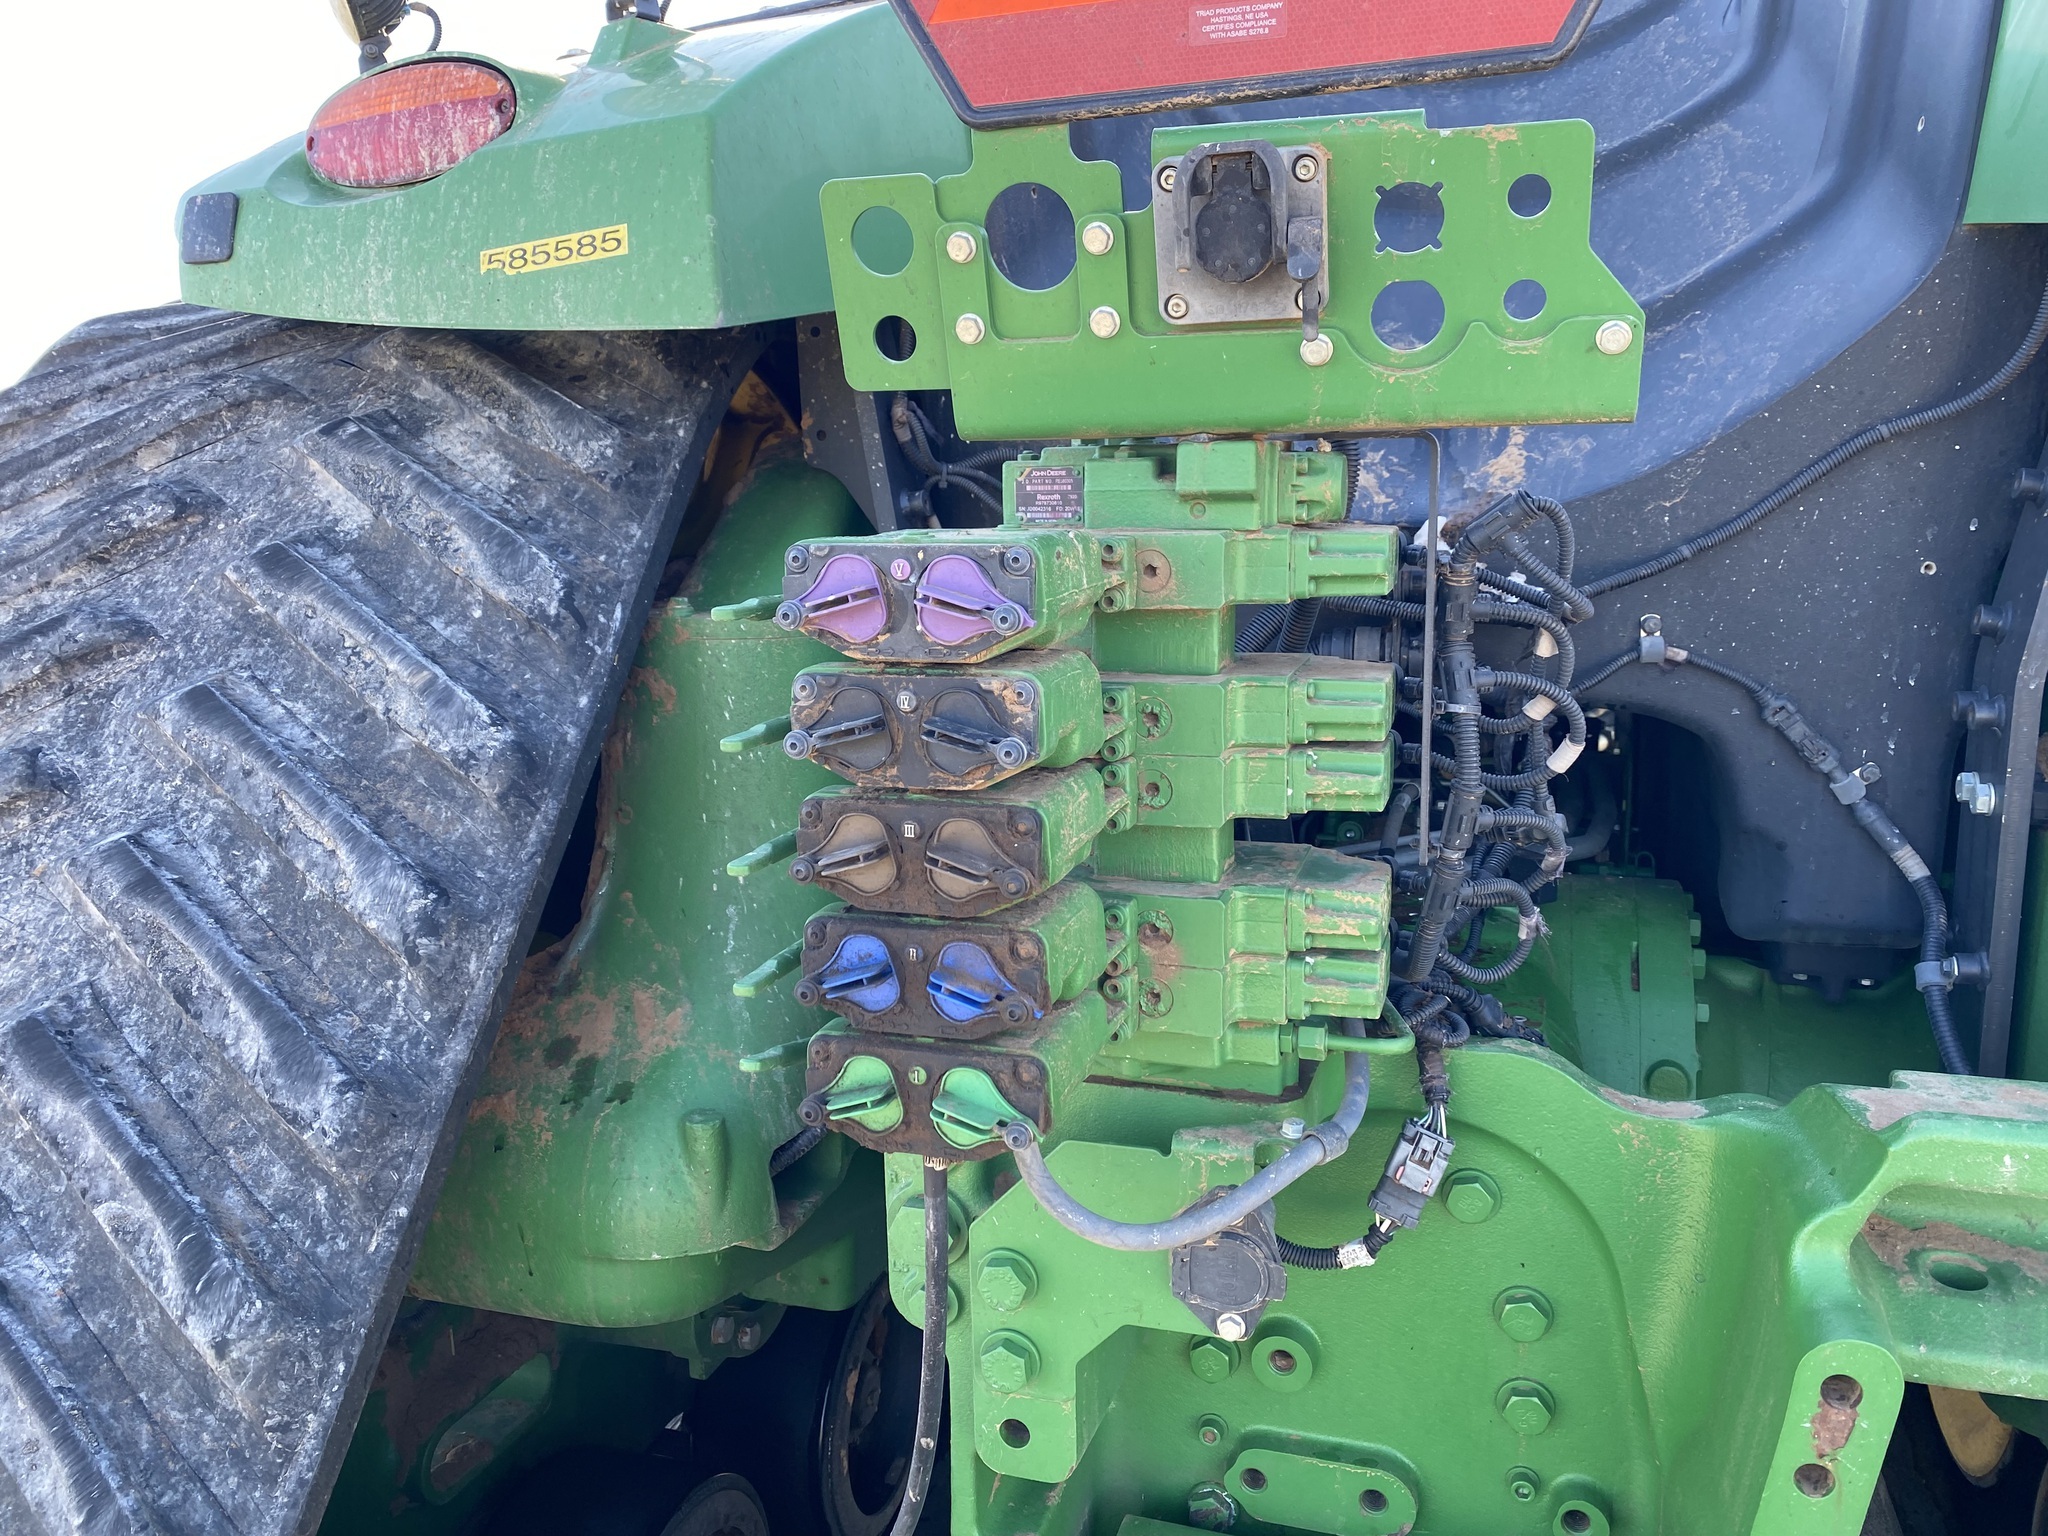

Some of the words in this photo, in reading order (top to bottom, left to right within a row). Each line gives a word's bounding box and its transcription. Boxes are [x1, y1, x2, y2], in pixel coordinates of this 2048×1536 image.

[1196, 9, 1215, 17] TRIAD
[1216, 5, 1250, 15] PRODUCTS
[1252, 2, 1283, 11] COMPANY
[1255, 11, 1269, 19] USA
[1202, 23, 1234, 32] CERTIFIES
[1236, 19, 1276, 29] COMPLIANCE
[1209, 32, 1226, 40] WITH
[1226, 29, 1248, 38] ASABE
[486, 229, 623, 271] 585585
[893, 562, 905, 577] V
[899, 695, 910, 709] IV
[903, 824, 915, 838] III
